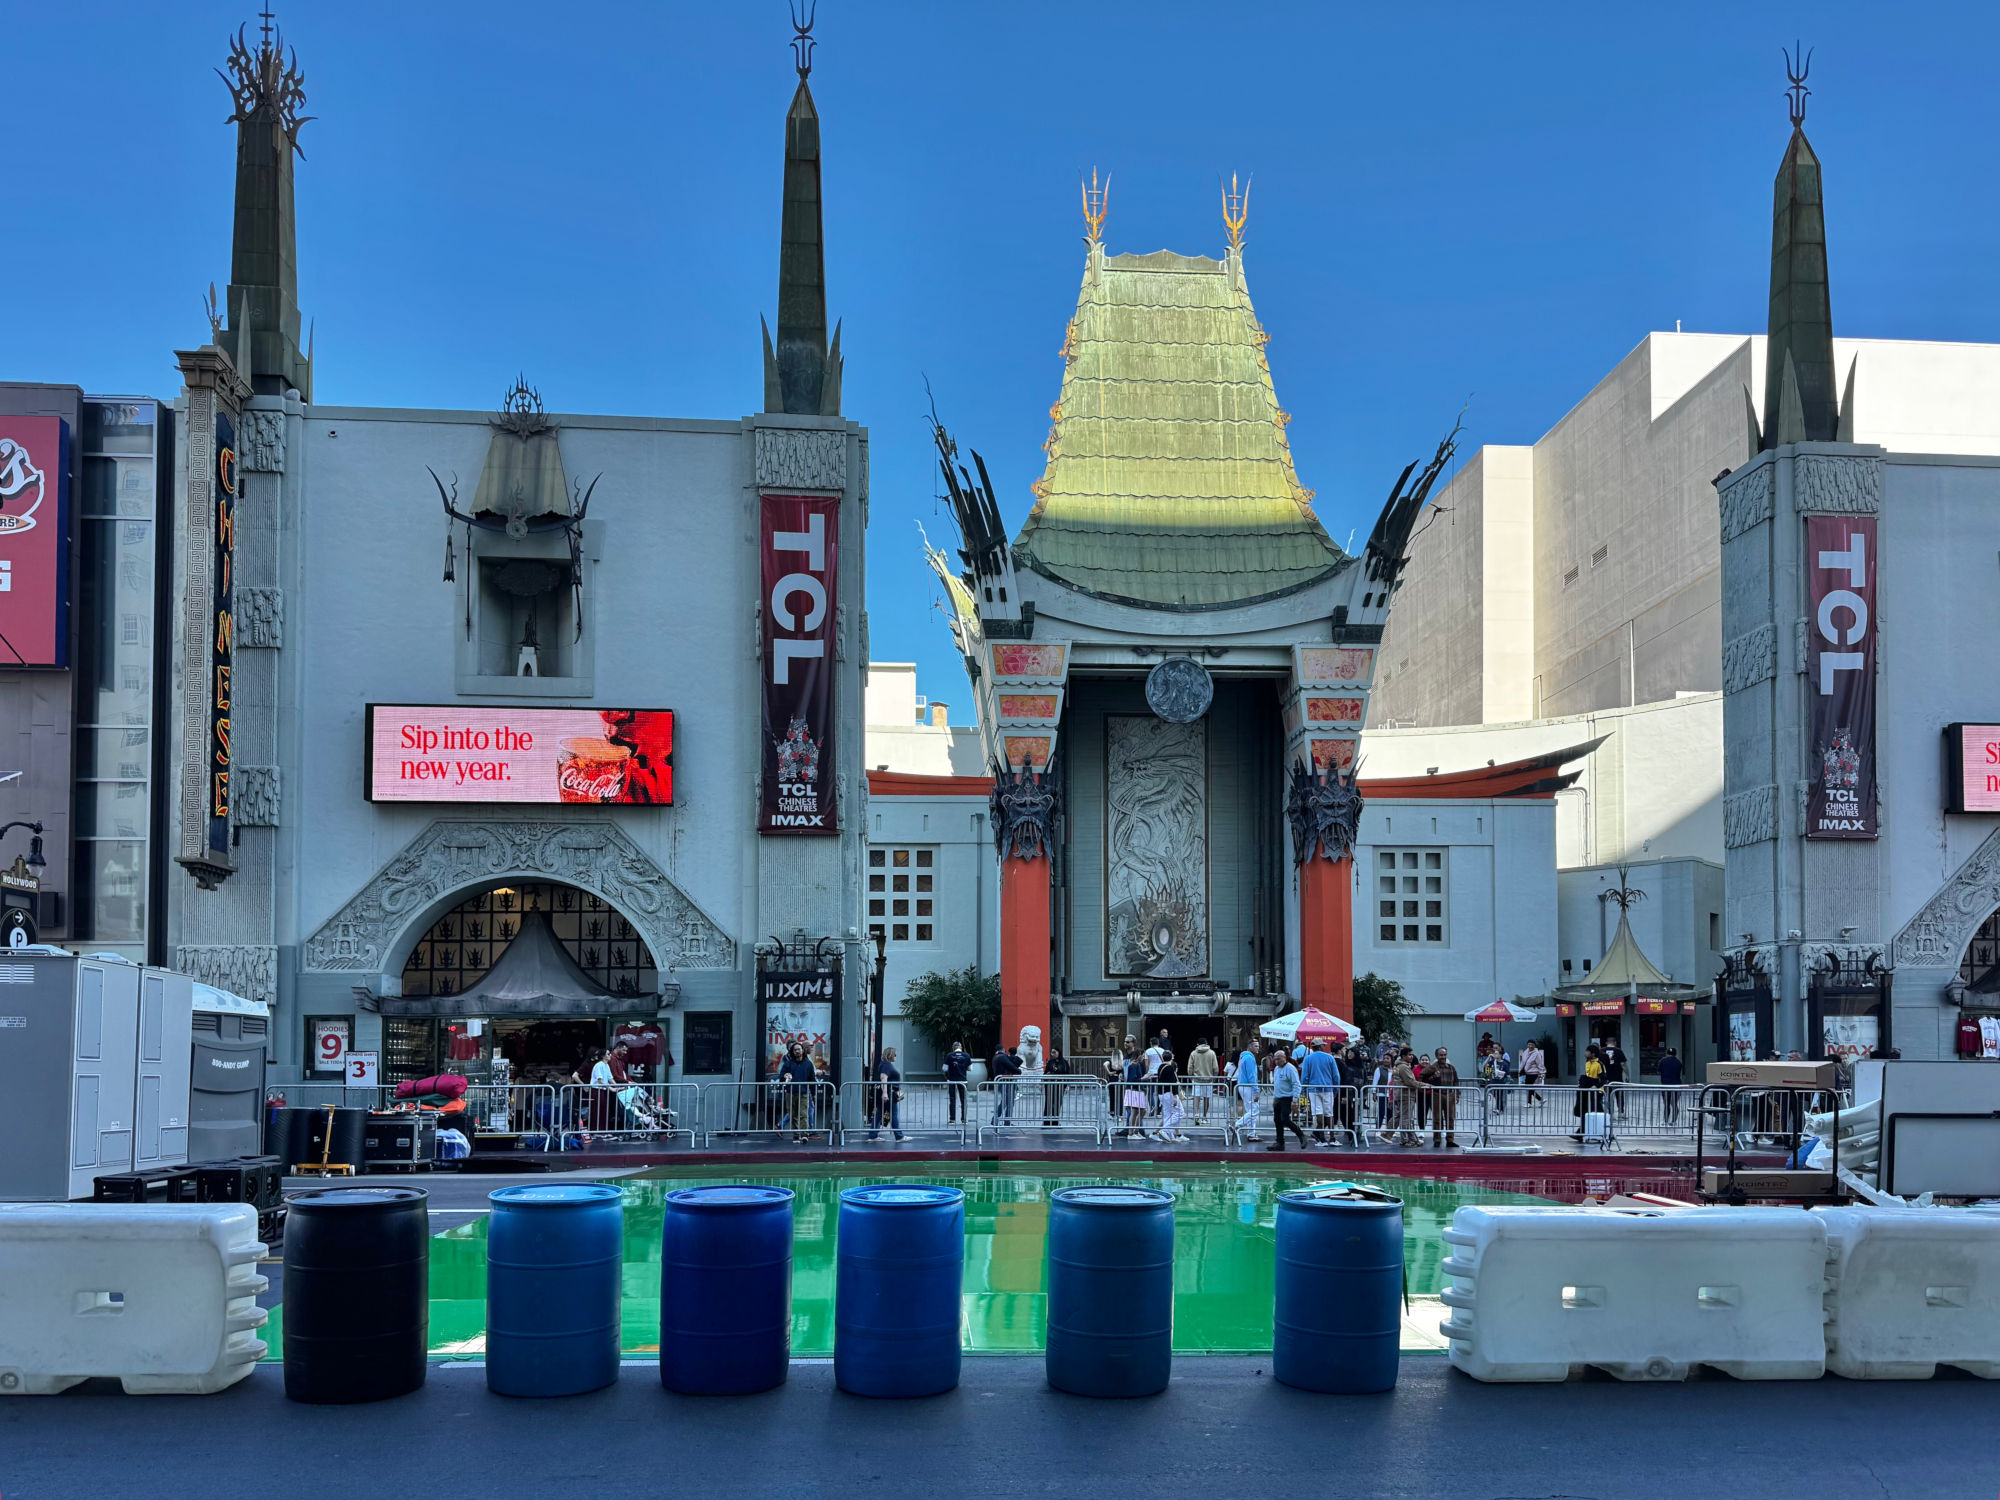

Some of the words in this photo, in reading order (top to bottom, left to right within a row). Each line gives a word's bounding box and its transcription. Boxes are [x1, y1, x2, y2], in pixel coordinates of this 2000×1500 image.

[771, 513, 827, 685] TCL
[1817, 533, 1868, 695] TCL
[215, 447, 235, 816] CHINESE
[400, 724, 438, 754] Sip
[443, 726, 489, 751] into
[495, 726, 533, 751] the
[400, 760, 450, 780] new
[455, 761, 512, 785] year.
[779, 784, 818, 796] TCL
[1825, 790, 1859, 802] TCL
[778, 797, 817, 805] CHINESE
[1825, 802, 1859, 811] CHINESE
[778, 804, 818, 812] THEATRES
[1825, 809, 1859, 817] THEATRES
[771, 814, 824, 826] IMAX
[1819, 819, 1865, 831] IMAX
[2, 875, 37, 889] HOLLYWOOD
[16, 932, 23, 947] P
[768, 1032, 827, 1045] IMAX
[1731, 1040, 1756, 1050] IMA
